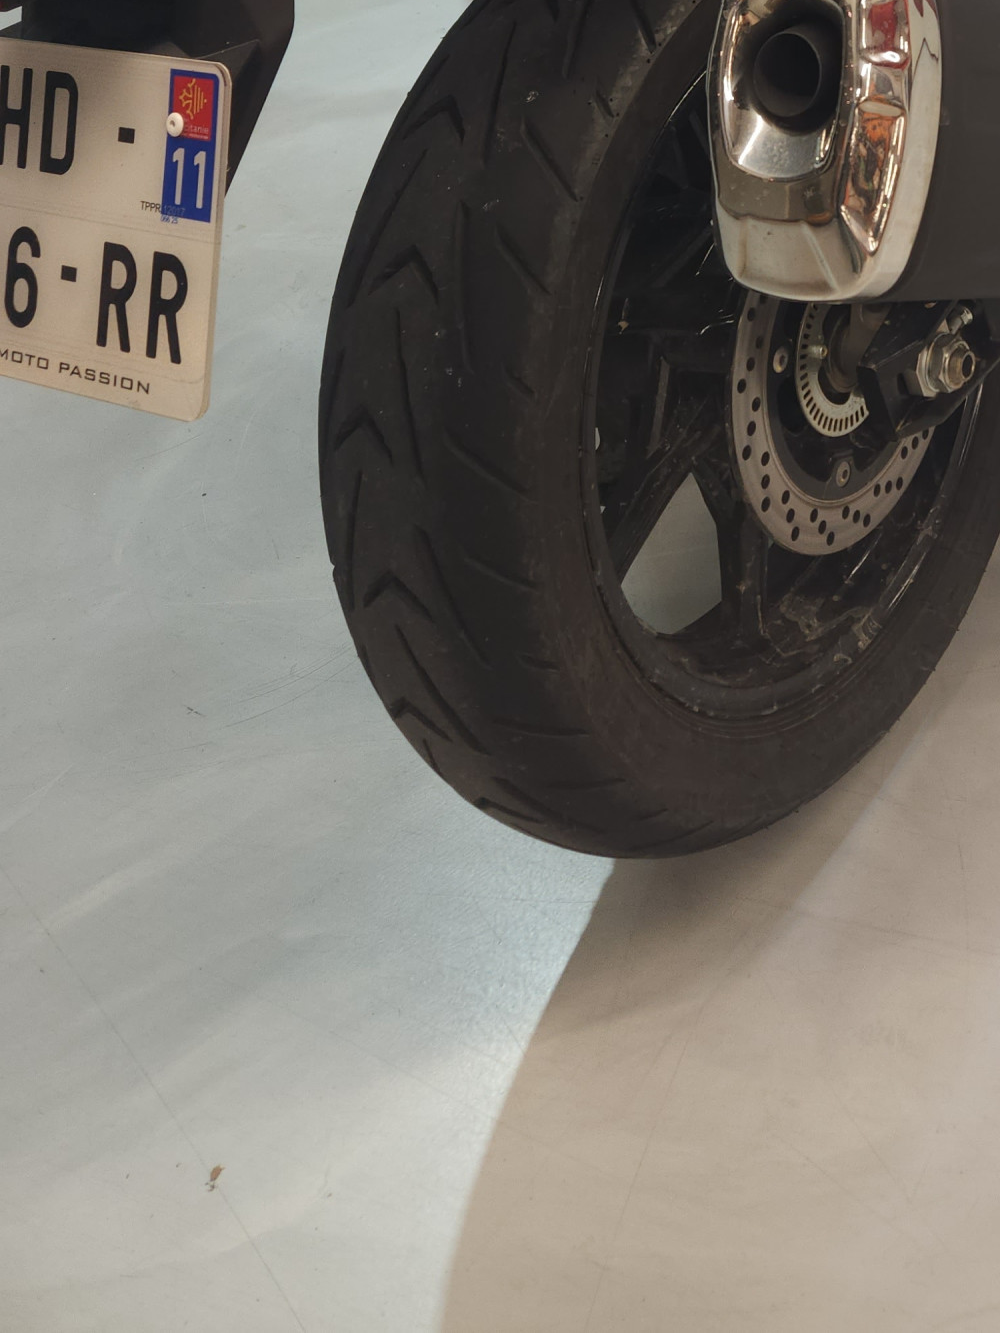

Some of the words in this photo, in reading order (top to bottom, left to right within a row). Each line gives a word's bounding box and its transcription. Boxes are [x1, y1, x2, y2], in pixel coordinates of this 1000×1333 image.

[0, 65, 79, 176] HD
[172, 147, 207, 209] 11
[0, 348, 49, 370] MOTO
[58, 362, 150, 395] PASSION
